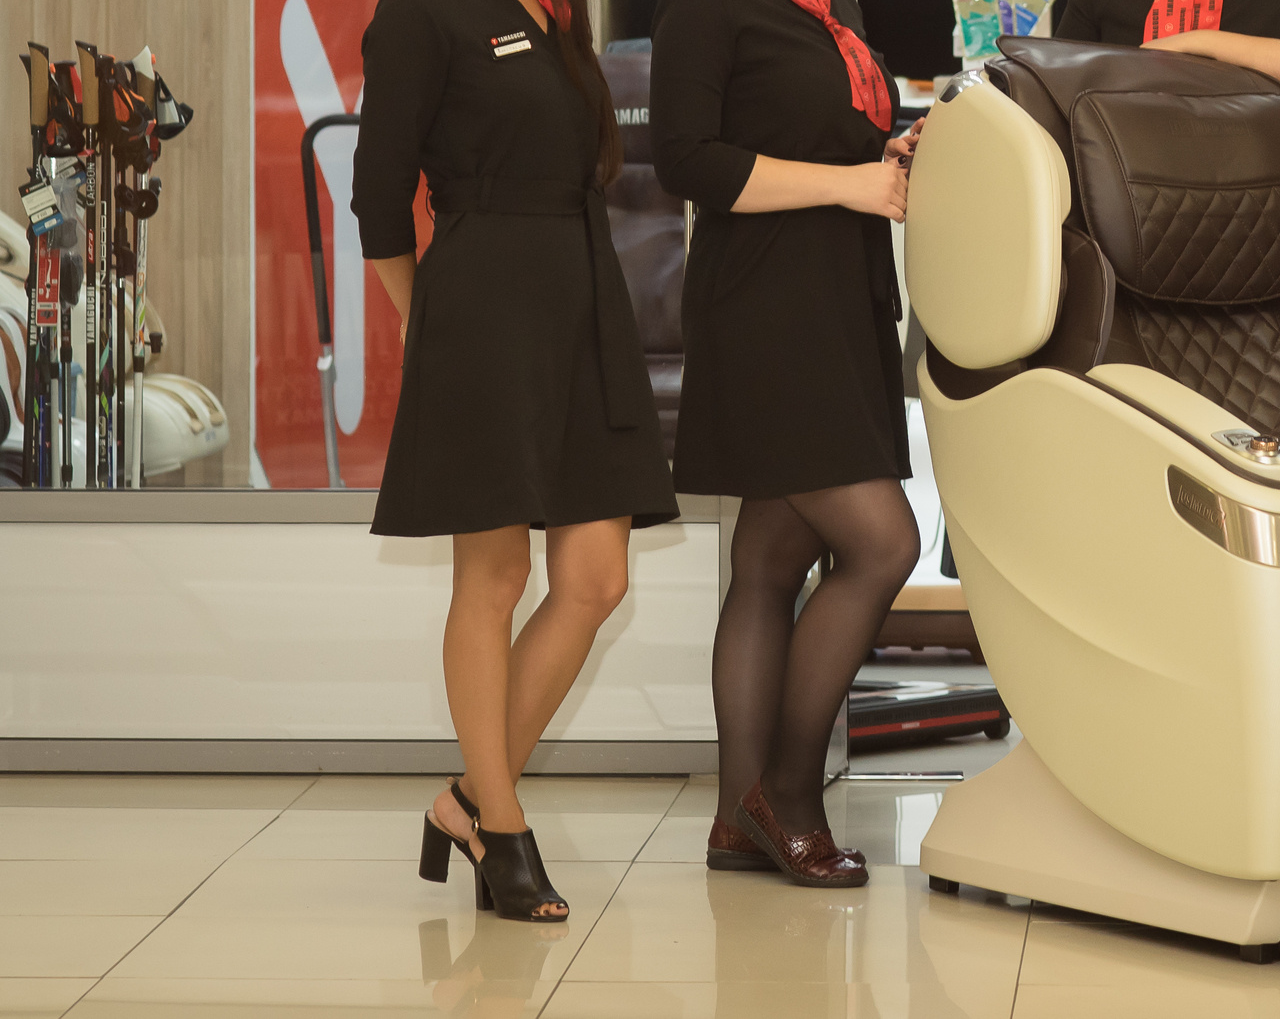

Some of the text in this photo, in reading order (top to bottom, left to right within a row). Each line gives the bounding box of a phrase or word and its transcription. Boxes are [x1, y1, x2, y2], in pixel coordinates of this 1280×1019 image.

[497, 31, 526, 43] YAMAGUCHI
[86, 162, 95, 207] CARBON
[86, 286, 95, 343] YAMAGUCHI
